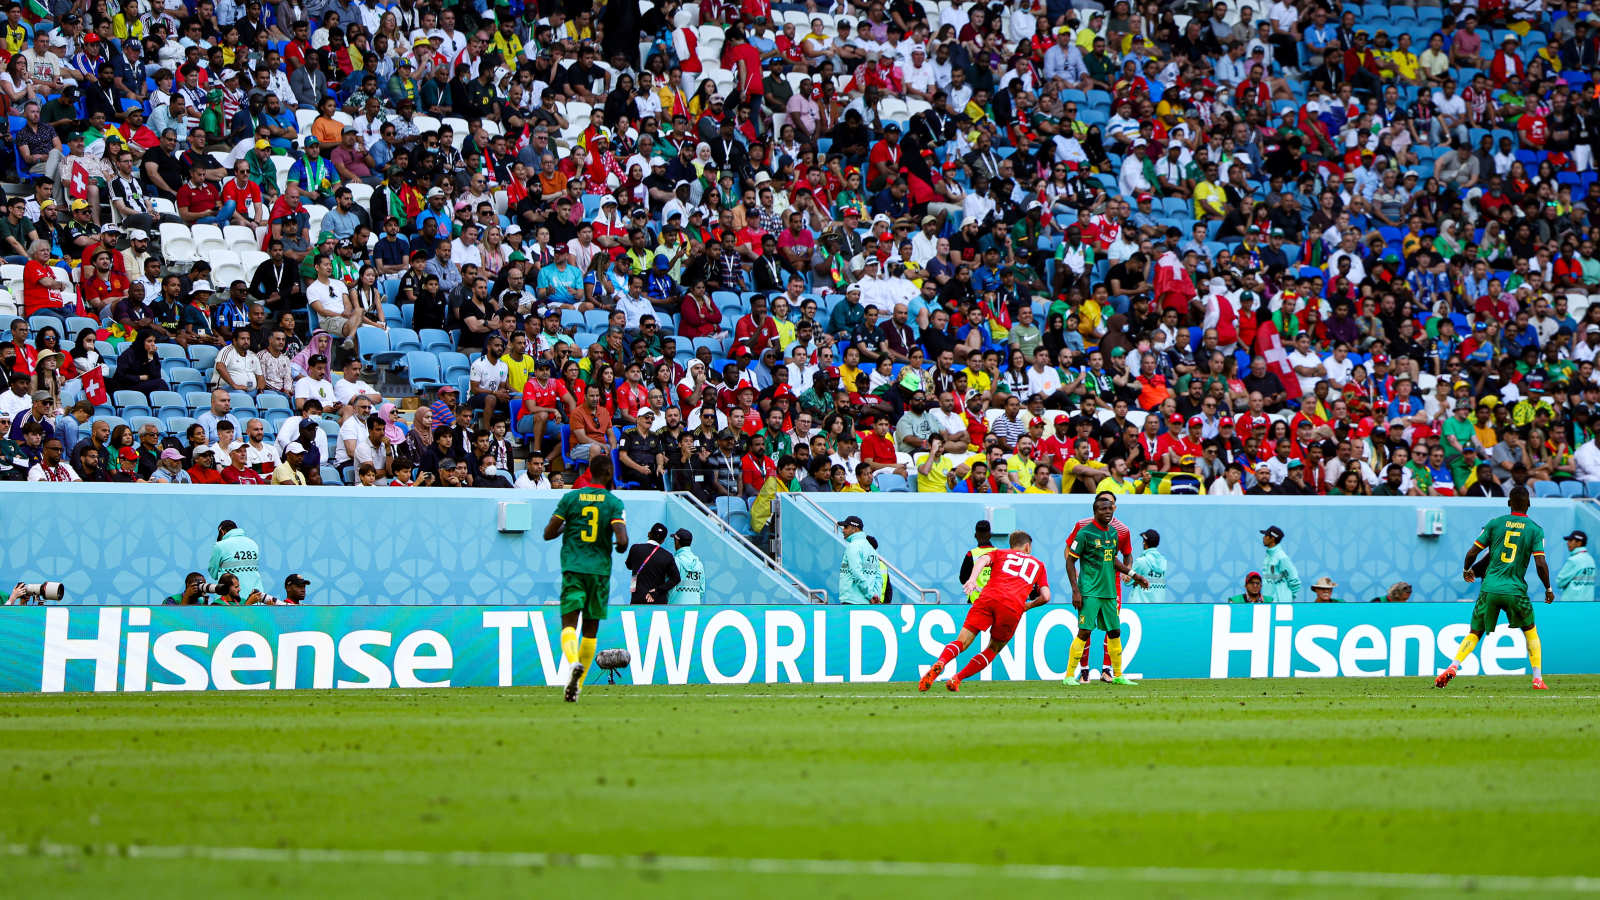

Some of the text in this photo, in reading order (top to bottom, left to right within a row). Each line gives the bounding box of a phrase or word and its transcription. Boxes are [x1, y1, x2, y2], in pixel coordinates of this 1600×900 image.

[581, 506, 599, 542] 3
[233, 550, 258, 561] 4283
[1500, 530, 1521, 563] 5
[1002, 553, 1040, 585] 20
[41, 606, 454, 693] Hisense
[482, 610, 588, 687] TV
[1210, 604, 1528, 678] Hisense
